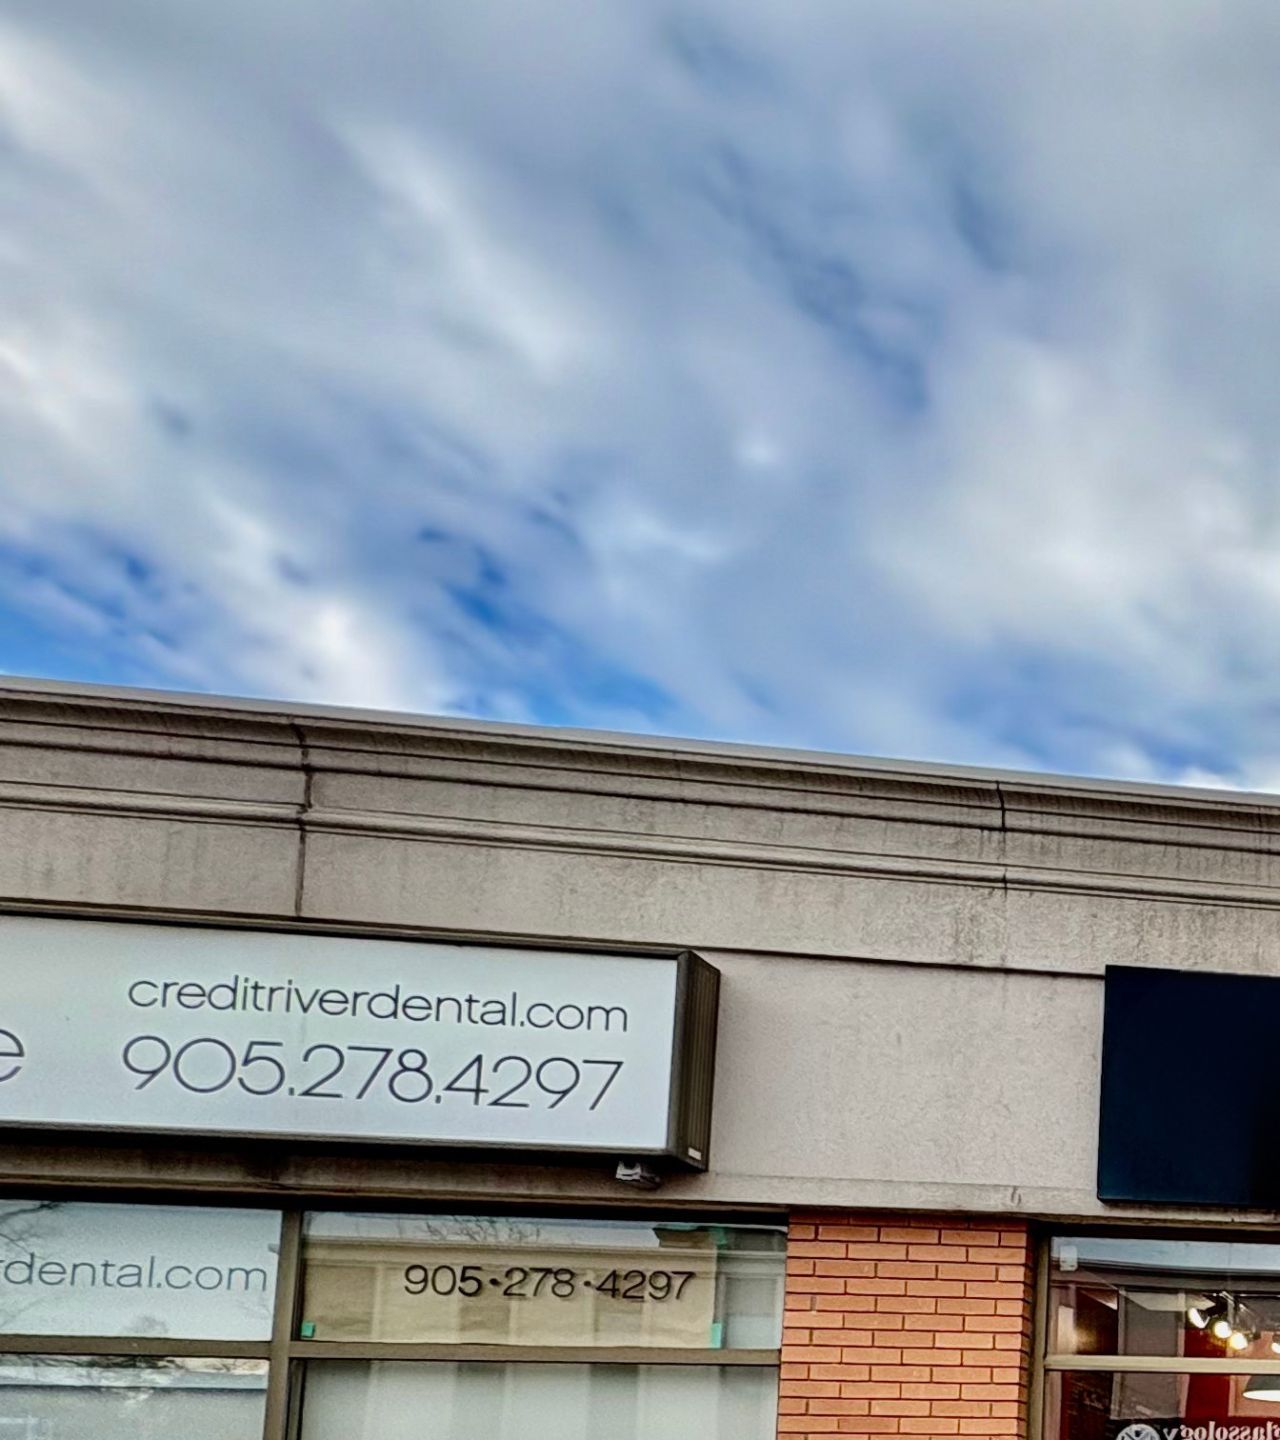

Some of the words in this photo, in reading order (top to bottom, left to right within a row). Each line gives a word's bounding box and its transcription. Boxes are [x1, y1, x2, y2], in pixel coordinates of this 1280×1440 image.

[127, 975, 628, 1032] creditriverdental.com
[122, 1034, 625, 1111] 905.278.4297
[0, 1252, 268, 1294] dental.com
